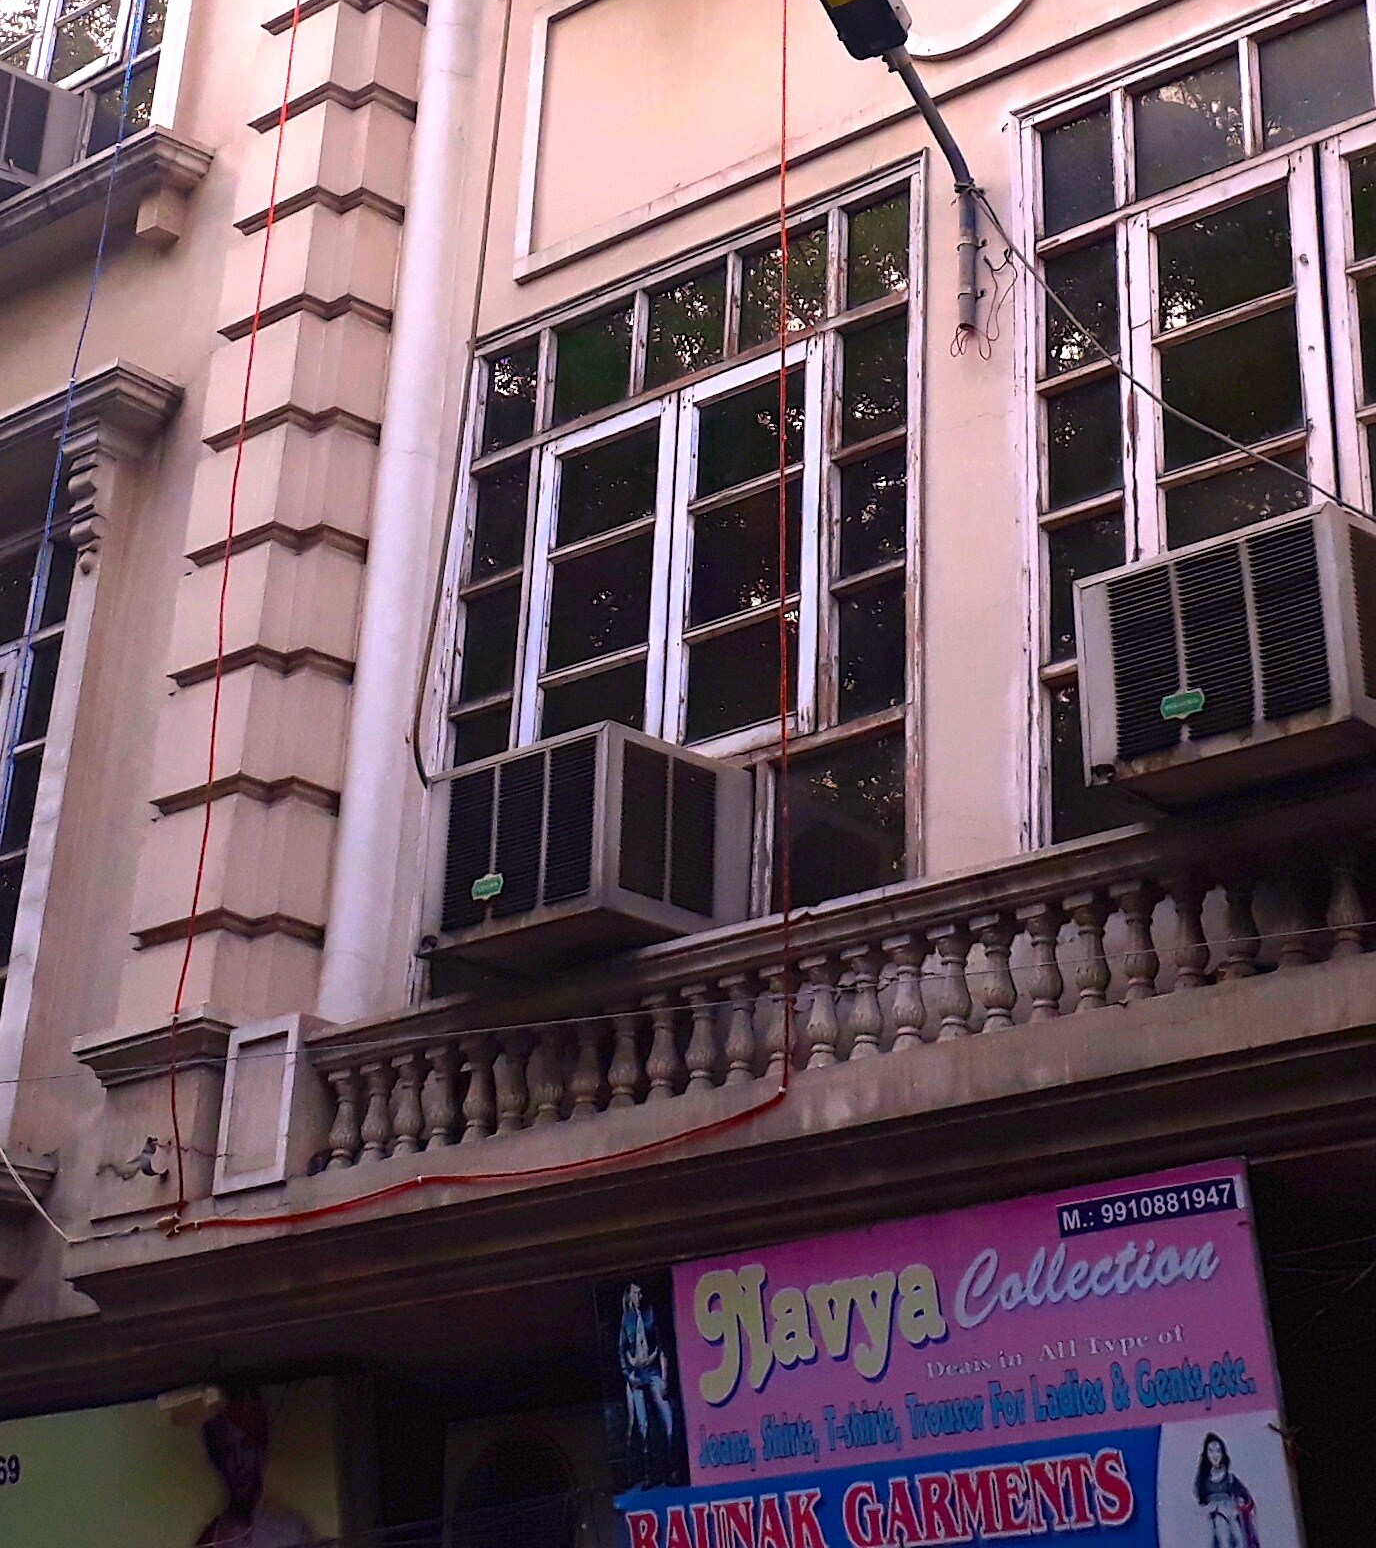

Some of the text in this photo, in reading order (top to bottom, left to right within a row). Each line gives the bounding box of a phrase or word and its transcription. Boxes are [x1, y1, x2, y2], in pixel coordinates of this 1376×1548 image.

[1101, 1183, 1232, 1224] 9910881947
[694, 1239, 1221, 1406] Navya Collection
[998, 1350, 1023, 1368] in
[1038, 1340, 1077, 1363] All
[1083, 1334, 1150, 1359] Type
[1158, 1323, 1185, 1345] of
[905, 1392, 985, 1440] Trouser
[987, 1381, 1026, 1429] For
[1029, 1369, 1107, 1423] Ladies
[1110, 1362, 1132, 1412] &
[842, 1448, 1134, 1548] GARMENTS
